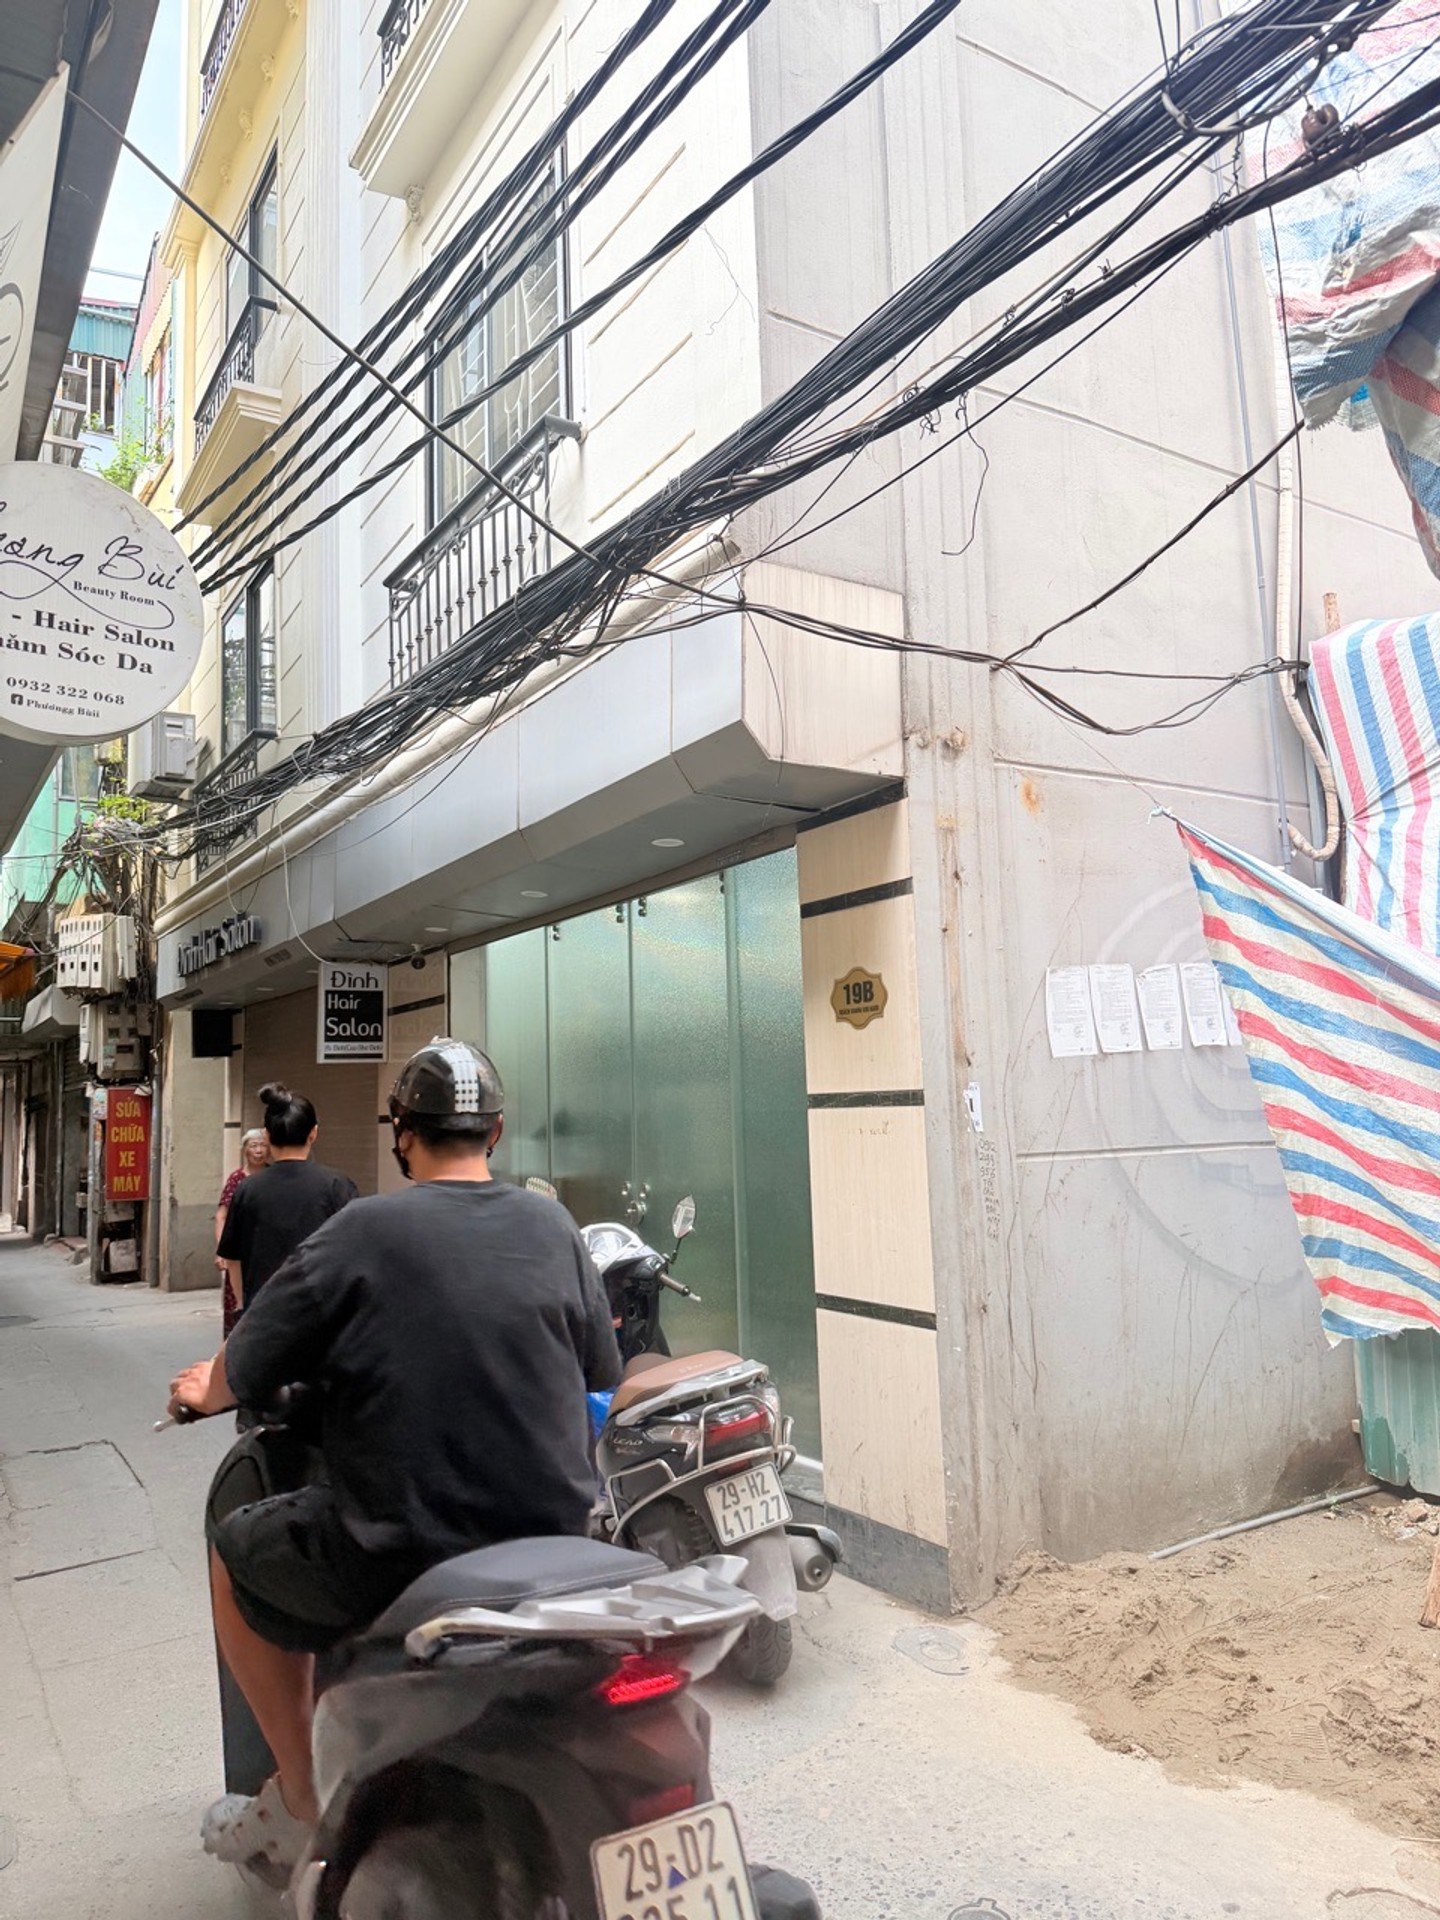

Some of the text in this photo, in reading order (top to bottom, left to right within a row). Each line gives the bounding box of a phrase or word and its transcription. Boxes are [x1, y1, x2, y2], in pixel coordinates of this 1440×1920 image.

[98, 535, 184, 589] Bùi
[73, 580, 155, 606] Beauty Room
[33, 609, 95, 637] Hair
[104, 623, 175, 652] Salon
[57, 641, 106, 666] Sóc
[116, 652, 153, 674] Da
[6, 676, 125, 705] 0932 322 068
[330, 970, 378, 989] Đình
[327, 993, 361, 1010] Hair
[843, 980, 874, 1005] 19B
[326, 1017, 382, 1037] Salon
[115, 1097, 141, 1118] SỬA
[110, 1123, 145, 1143] CHỮA
[118, 1150, 136, 1168] XE
[112, 1173, 142, 1193] MÁY
[716, 1471, 771, 1510] 29-H2
[722, 1494, 782, 1538] 417.27
[617, 1817, 724, 1903] 29-D2
